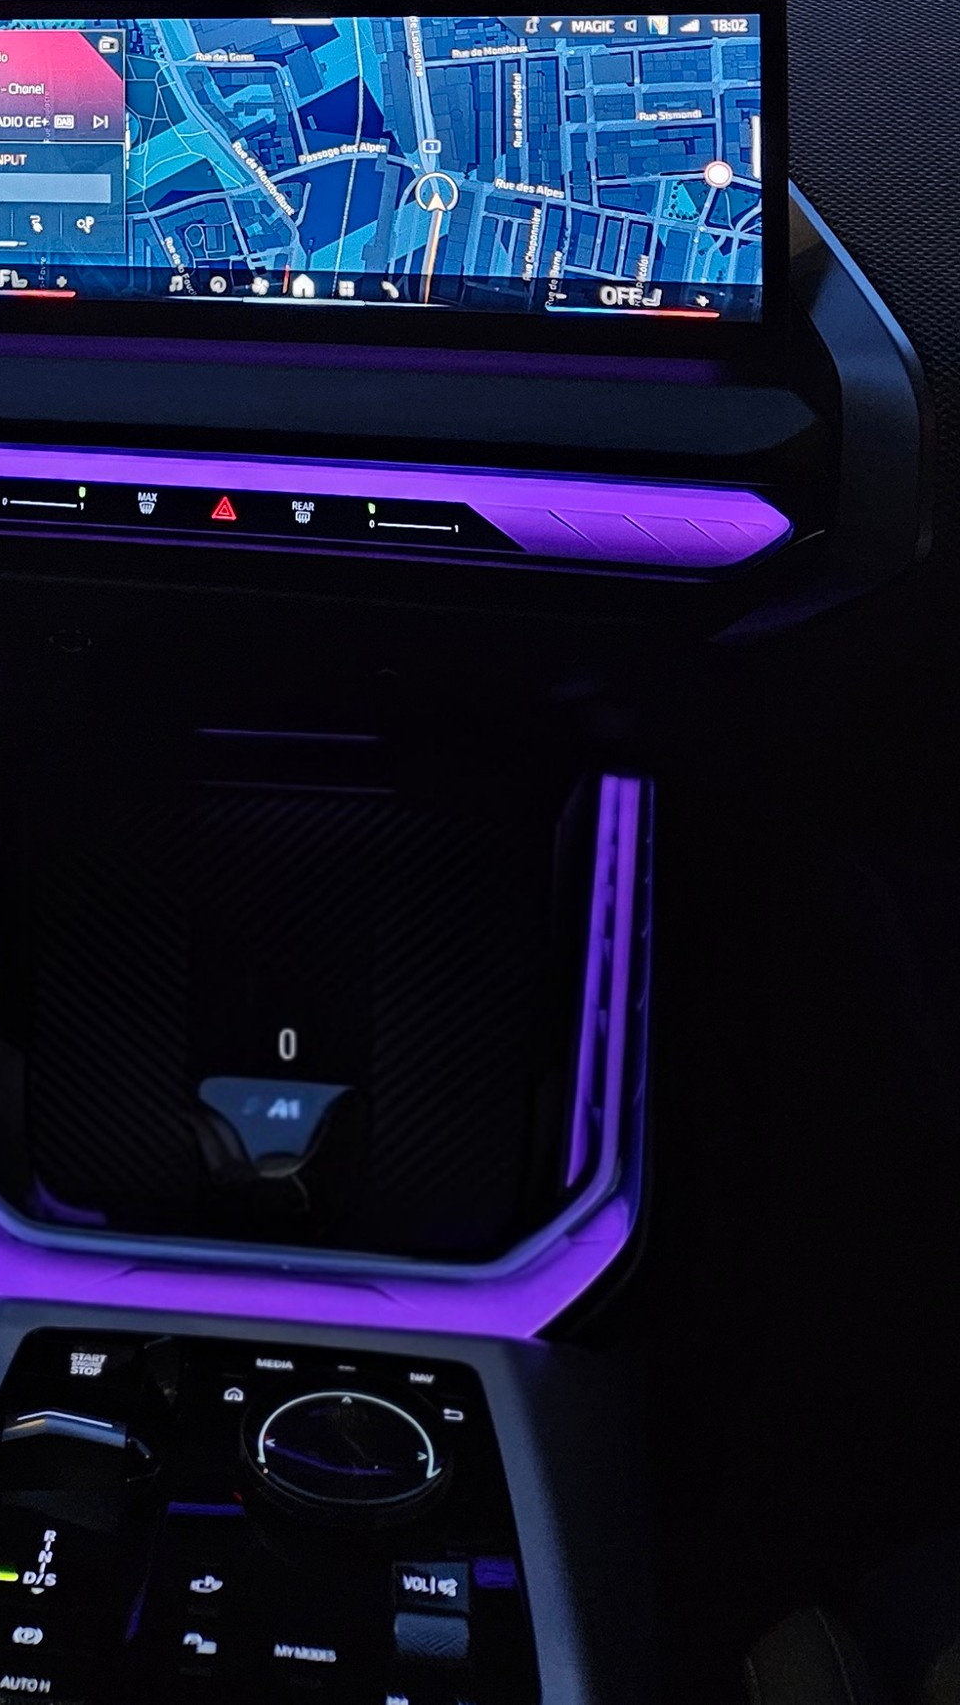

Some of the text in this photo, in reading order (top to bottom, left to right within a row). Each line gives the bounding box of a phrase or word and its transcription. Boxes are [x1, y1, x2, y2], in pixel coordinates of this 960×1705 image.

[571, 20, 615, 33] MAGIC
[710, 18, 748, 33] 18:02
[195, 52, 213, 61] Rue
[451, 44, 529, 59] Rue de Monthoux
[8, 82, 45, 96] Chanel
[25, 115, 49, 128] GE+
[639, 109, 702, 121] Rue Sismondi
[512, 132, 523, 148] Rue
[298, 142, 387, 165] Passage des Alpes
[231, 141, 295, 217] Rue de Montbrillant
[495, 177, 565, 199] Rue des Alpes
[522, 263, 533, 281] Rue
[600, 285, 642, 306] OFF
[2, 497, 8, 506] 0
[137, 491, 158, 502] MAX
[292, 500, 315, 511] REAR
[369, 519, 375, 528] 0
[70, 1352, 108, 1363] START
[255, 1358, 294, 1370] MEDIA
[70, 1366, 102, 1376] STOP
[409, 1372, 435, 1384] NAV
[43, 1529, 57, 1542] R
[38, 1550, 53, 1563] N
[22, 1571, 57, 1586] D/S
[402, 1574, 431, 1593] VOL
[274, 1644, 294, 1657] MY
[0, 1674, 51, 1693] AUTO H
